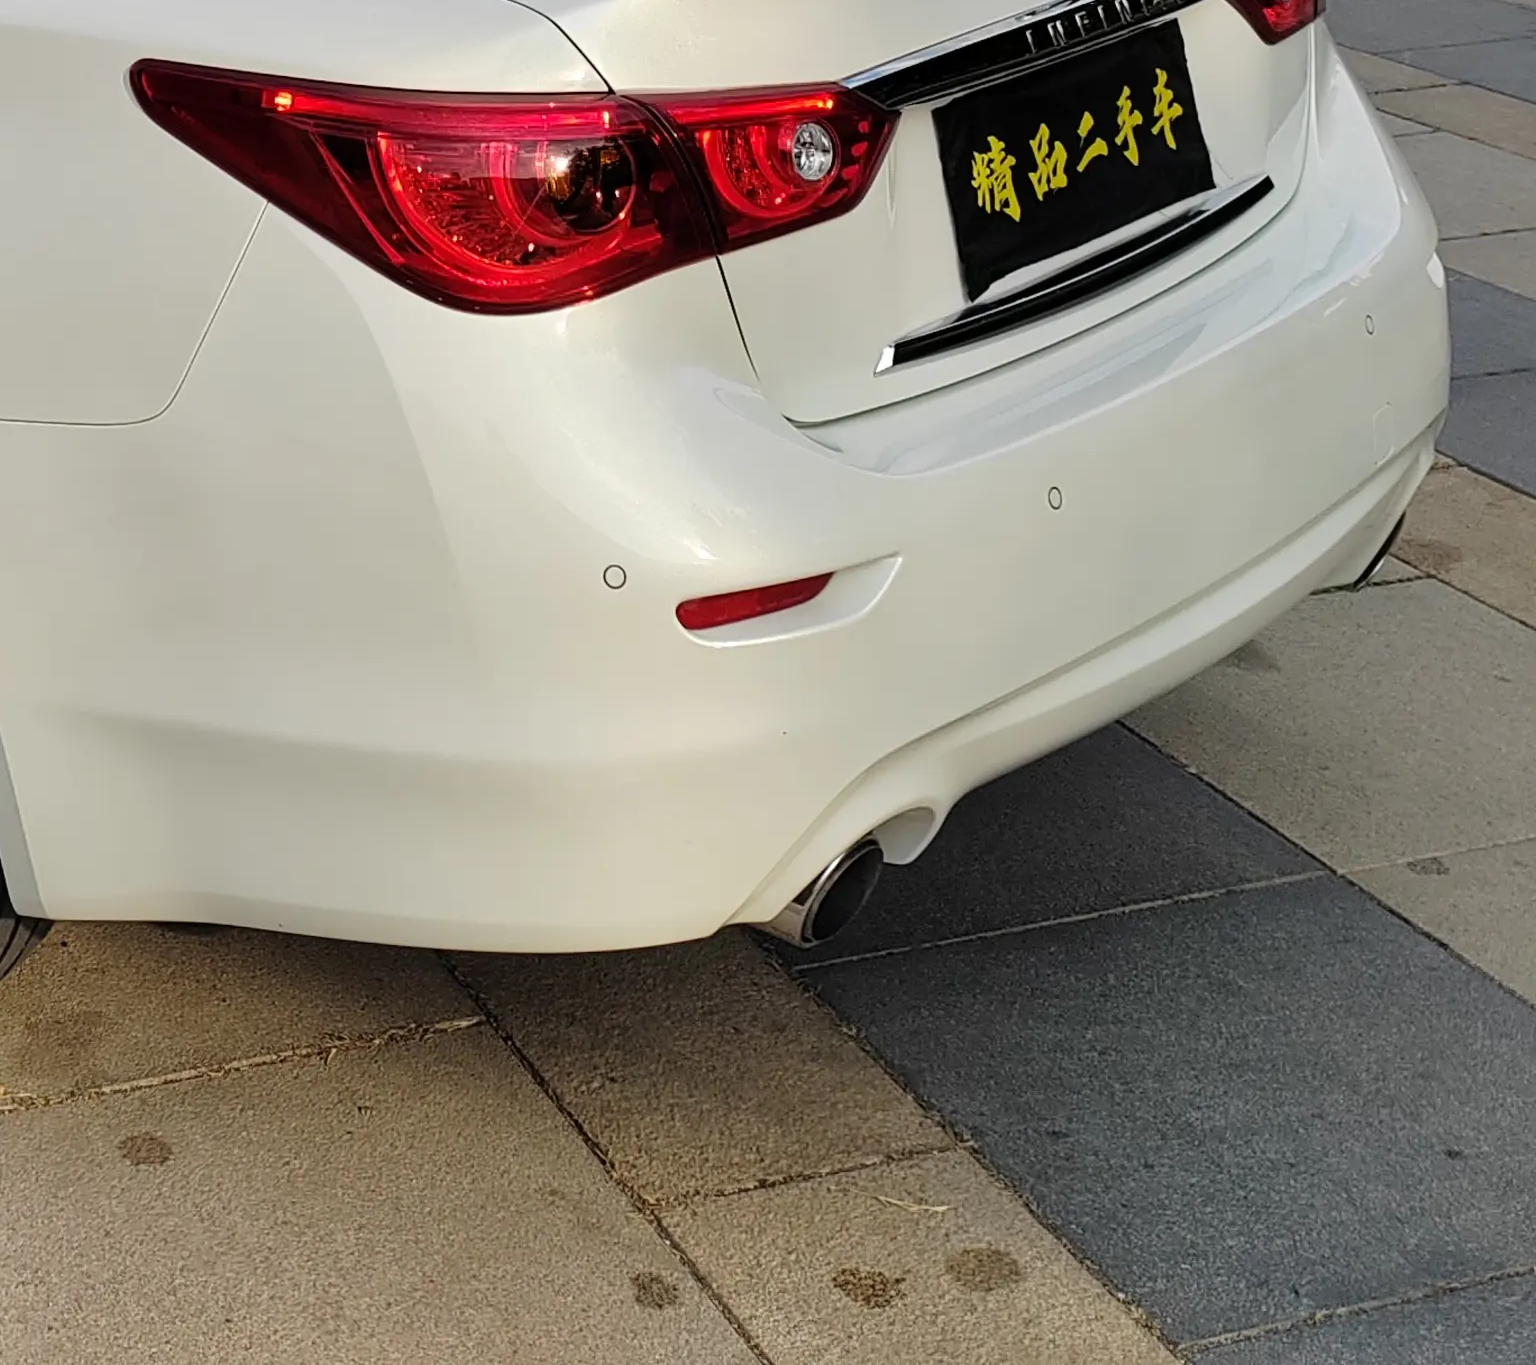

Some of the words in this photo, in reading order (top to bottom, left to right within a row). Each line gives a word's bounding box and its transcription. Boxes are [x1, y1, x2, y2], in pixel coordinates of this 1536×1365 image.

[970, 67, 1184, 223] 精品二手车
